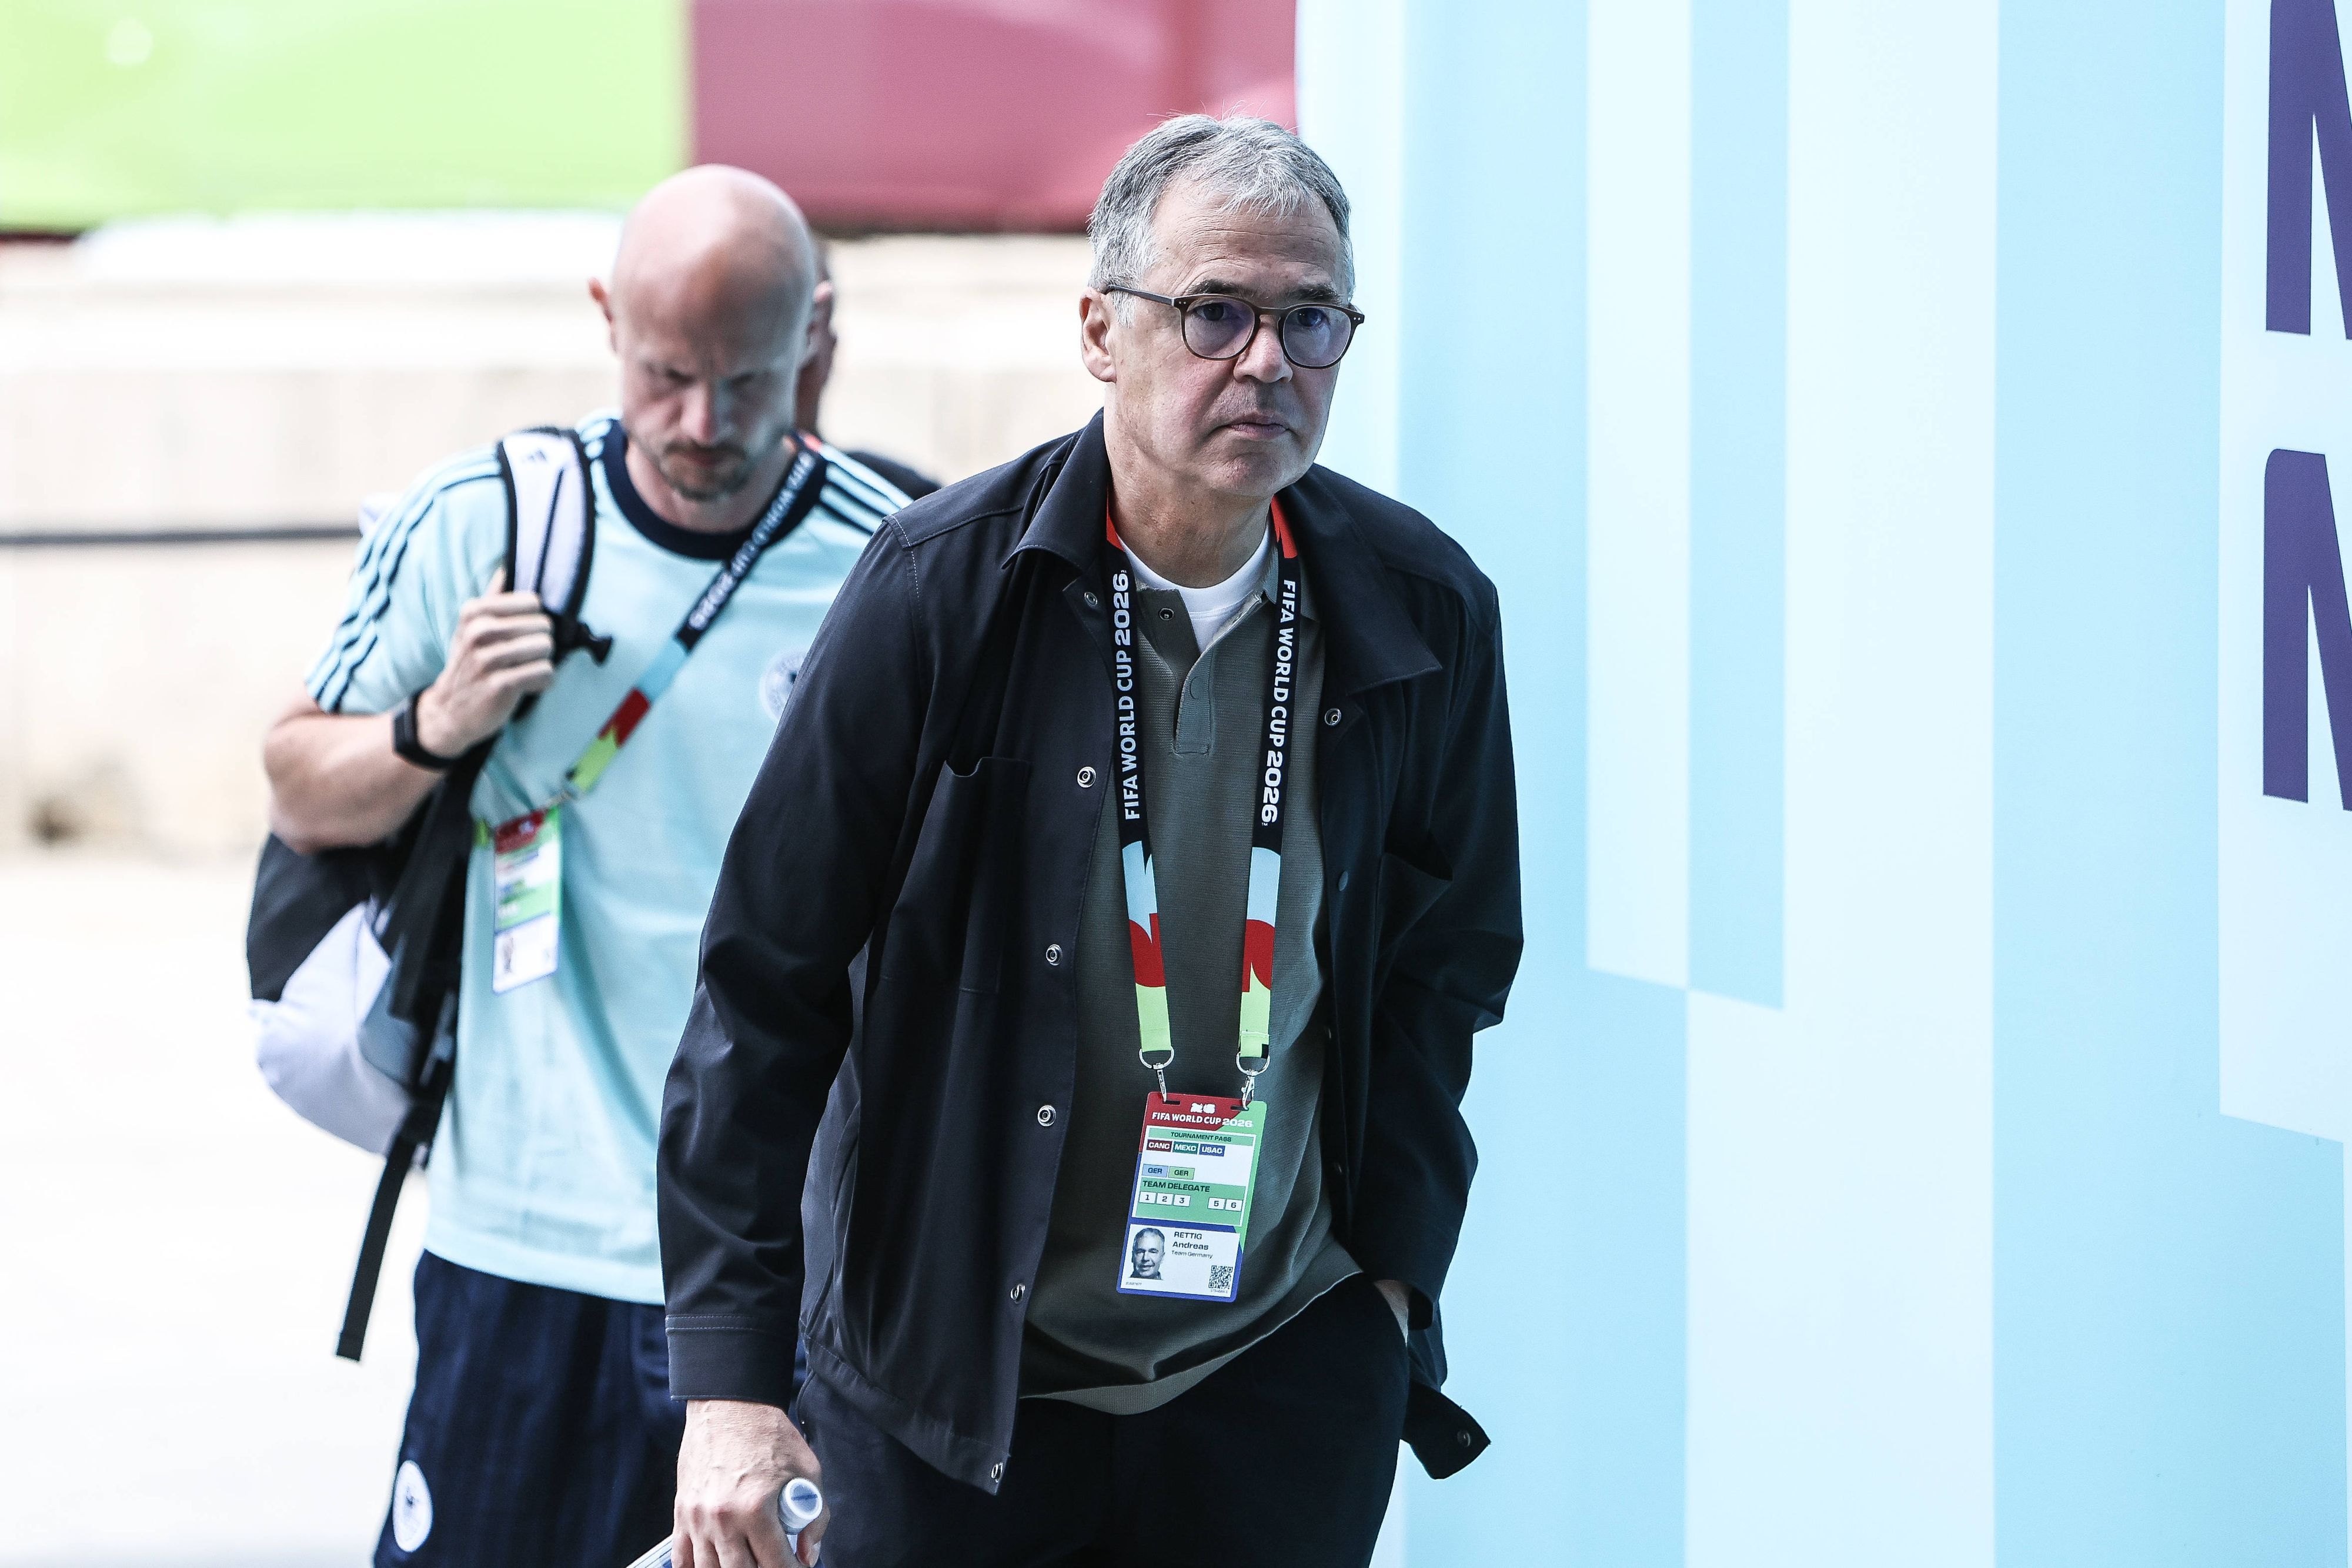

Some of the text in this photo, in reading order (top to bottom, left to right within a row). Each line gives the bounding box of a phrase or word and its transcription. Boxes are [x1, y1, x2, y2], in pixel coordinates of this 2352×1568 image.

[1112, 573, 1131, 646] 2026
[1280, 579, 1296, 623] FIFA
[1116, 650, 1133, 691] CUP
[1274, 627, 1294, 703] WORLD
[1118, 696, 1137, 773] WORLD
[1269, 706, 1287, 747] CUP
[1123, 774, 1140, 820] FIFA
[1261, 750, 1283, 823] 2026
[1152, 1112, 1254, 1128] FIFA WORLD CUP 2026
[1171, 1131, 1214, 1141] TOURNAMENT
[1148, 1141, 1223, 1154] CANC MEXC USAC
[1142, 1181, 1211, 1192] TEAM DELEGATE
[1172, 1241, 1209, 1251] Andreas
[1174, 1231, 1202, 1240] RETTIG
